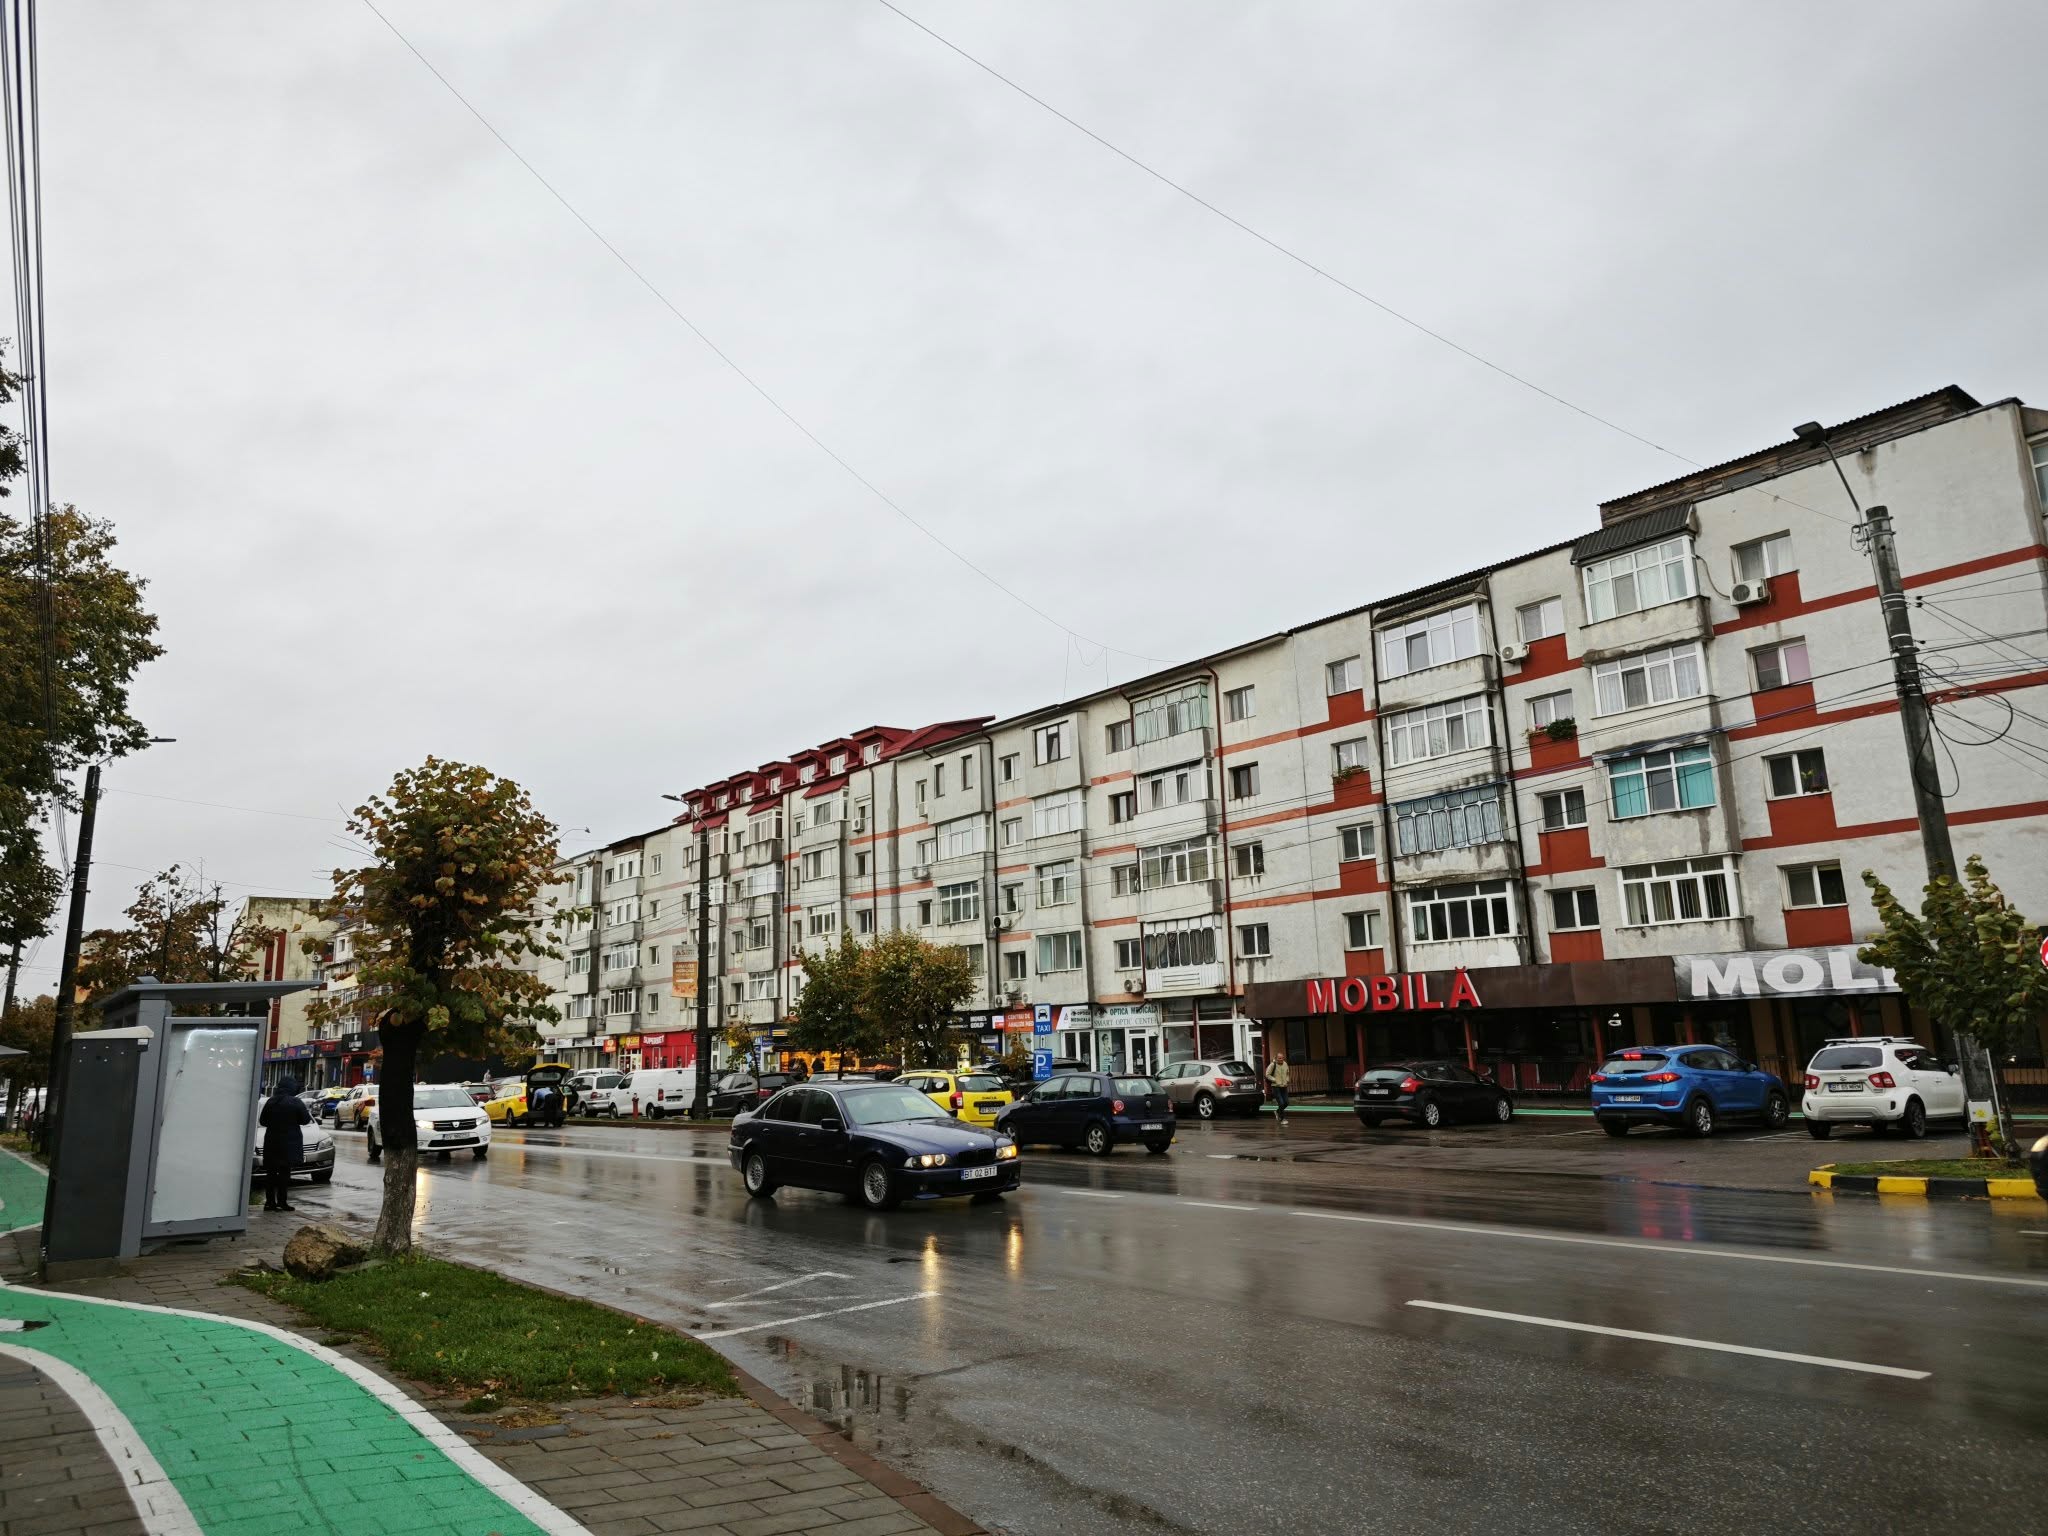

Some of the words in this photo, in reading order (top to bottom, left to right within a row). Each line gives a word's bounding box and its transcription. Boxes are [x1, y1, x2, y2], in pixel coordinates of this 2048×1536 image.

[1691, 951, 1899, 997] MOL
[1306, 966, 1483, 1015] MOBILĂ
[1109, 1007, 1129, 1016] OPTICA
[1115, 1018, 1133, 1026] OPTIC
[642, 1034, 666, 1046] SUPERBET
[1035, 1054, 1047, 1074] P
[963, 1169, 973, 1179] BT
[974, 1168, 984, 1178] 02
[984, 1166, 997, 1177] BTT
